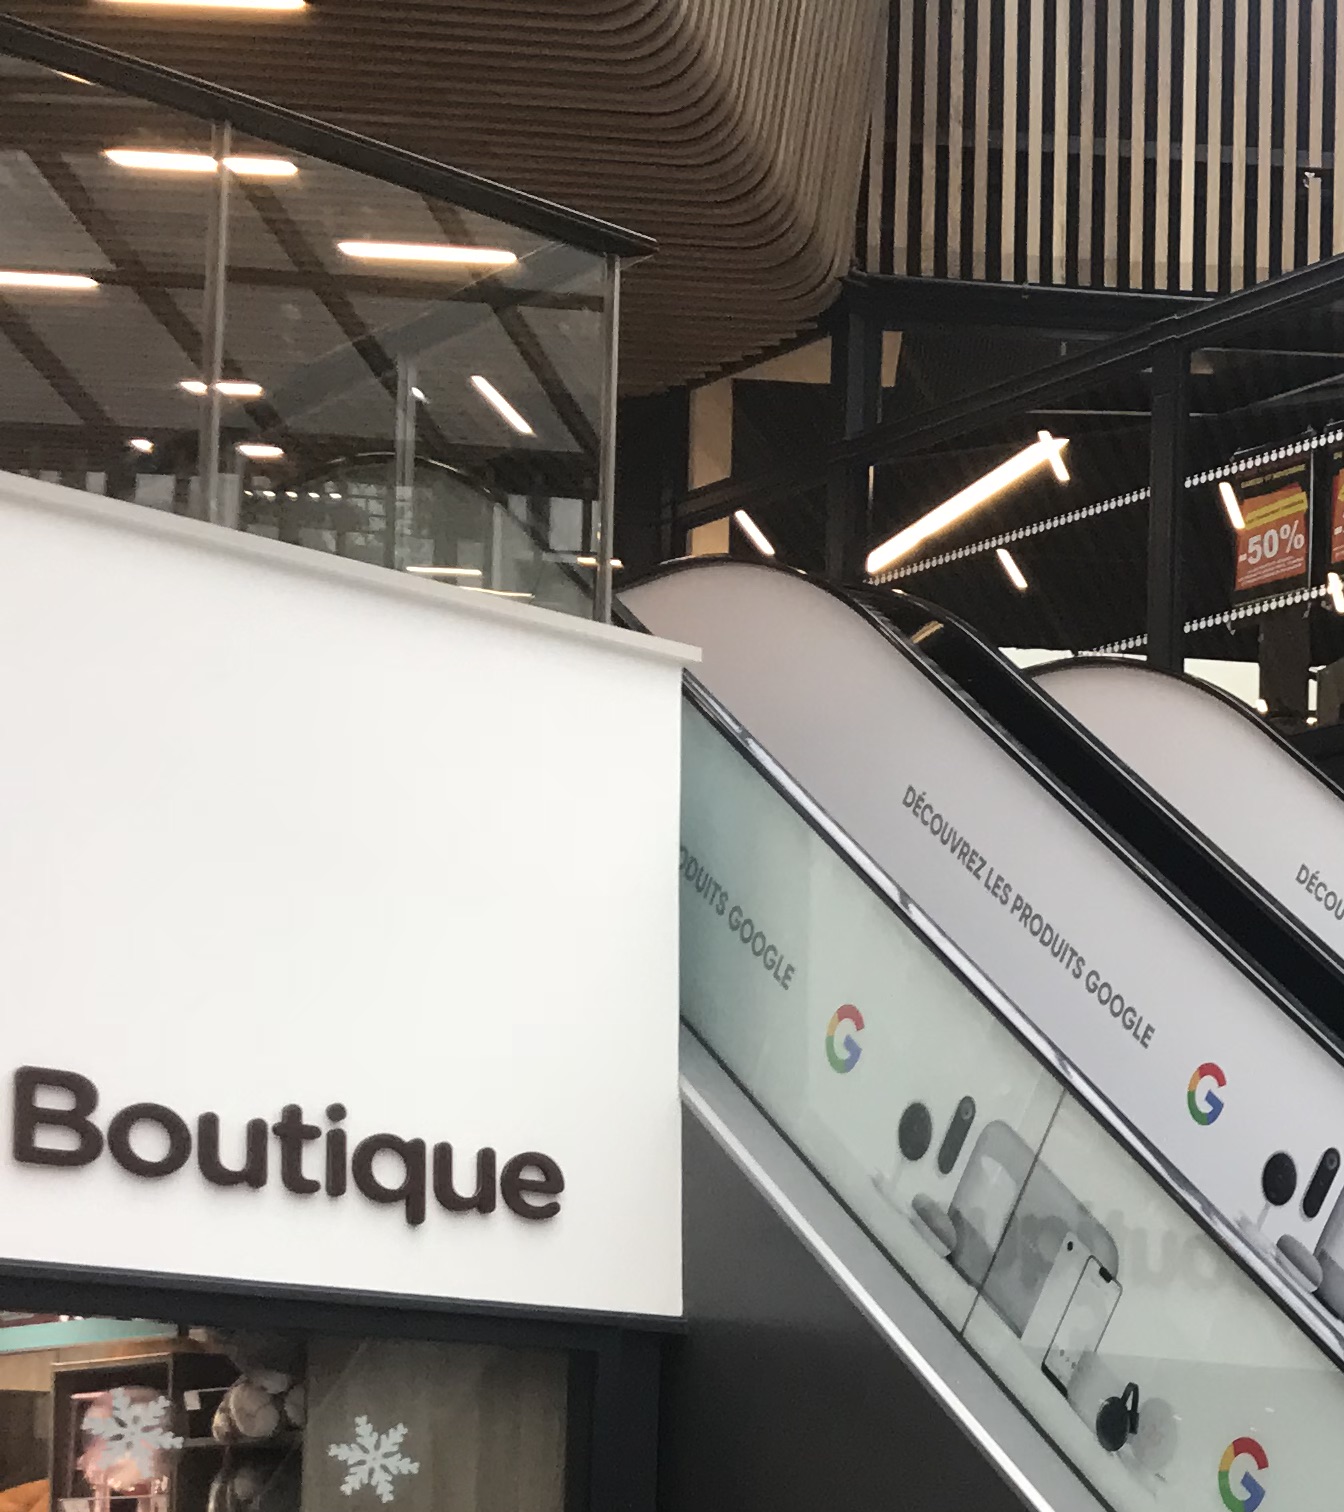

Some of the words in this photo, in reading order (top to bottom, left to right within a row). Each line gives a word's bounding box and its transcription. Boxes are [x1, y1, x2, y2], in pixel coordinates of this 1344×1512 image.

[1238, 519, 1305, 565] -50%
[680, 844, 729, 917] ODUITS
[729, 904, 796, 992] GOOGLE
[902, 784, 987, 882] DÉCOUVREZ
[983, 865, 1014, 907] LES
[1009, 896, 1085, 980] PRODUITS
[1084, 968, 1156, 1050] GOOGLE
[12, 1065, 565, 1226] Boutique
